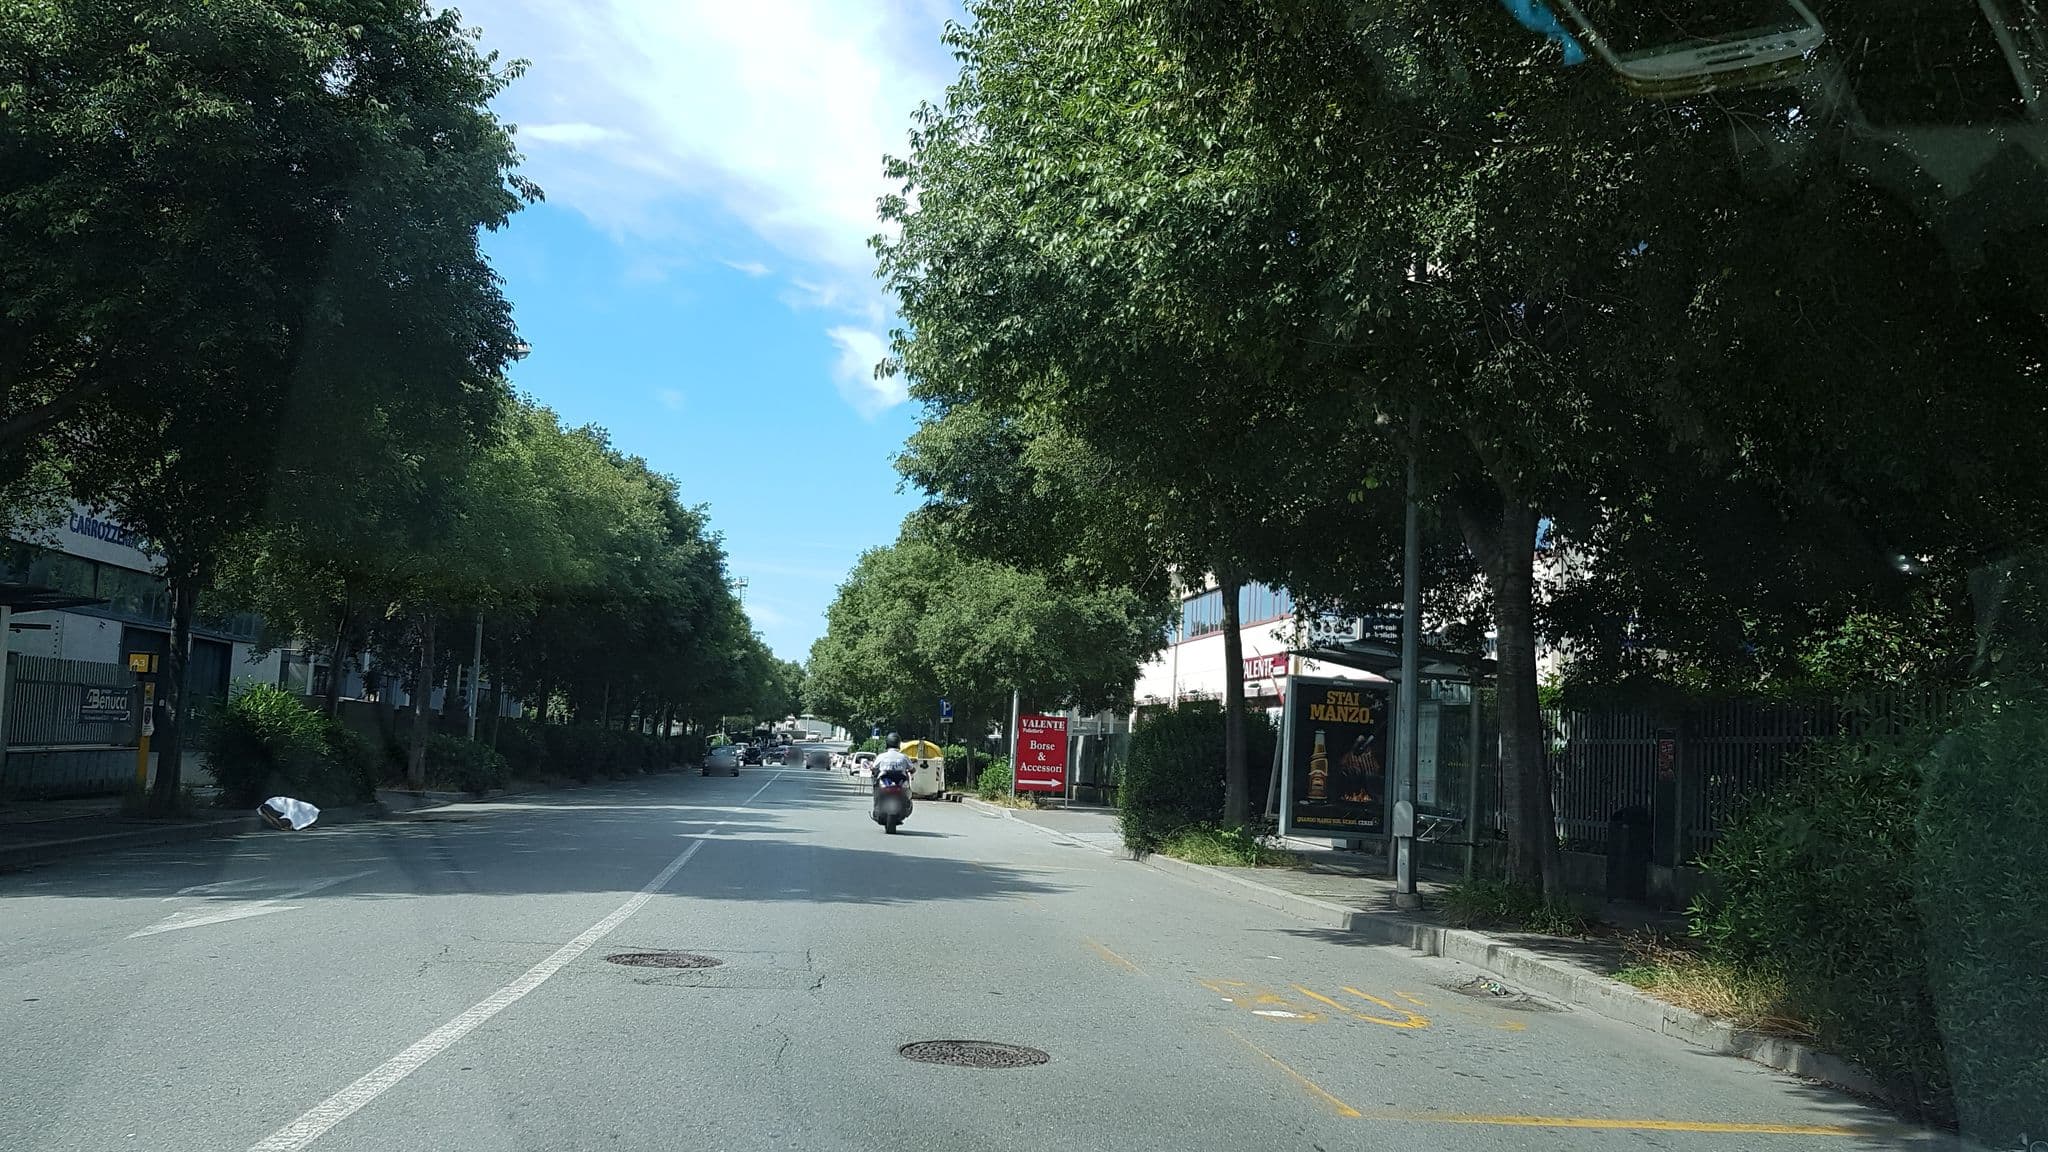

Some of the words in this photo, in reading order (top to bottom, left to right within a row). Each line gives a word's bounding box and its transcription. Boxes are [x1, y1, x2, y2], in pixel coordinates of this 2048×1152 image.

[132, 659, 145, 670] A3
[86, 688, 128, 710] Benucci
[1326, 690, 1360, 706] STAI
[943, 701, 951, 716] P
[1309, 703, 1375, 725] MANZO.
[1022, 719, 1065, 729] VALENTE
[1030, 740, 1056, 751] Borse
[1037, 751, 1047, 761] &
[1020, 762, 1062, 773] Accessori
